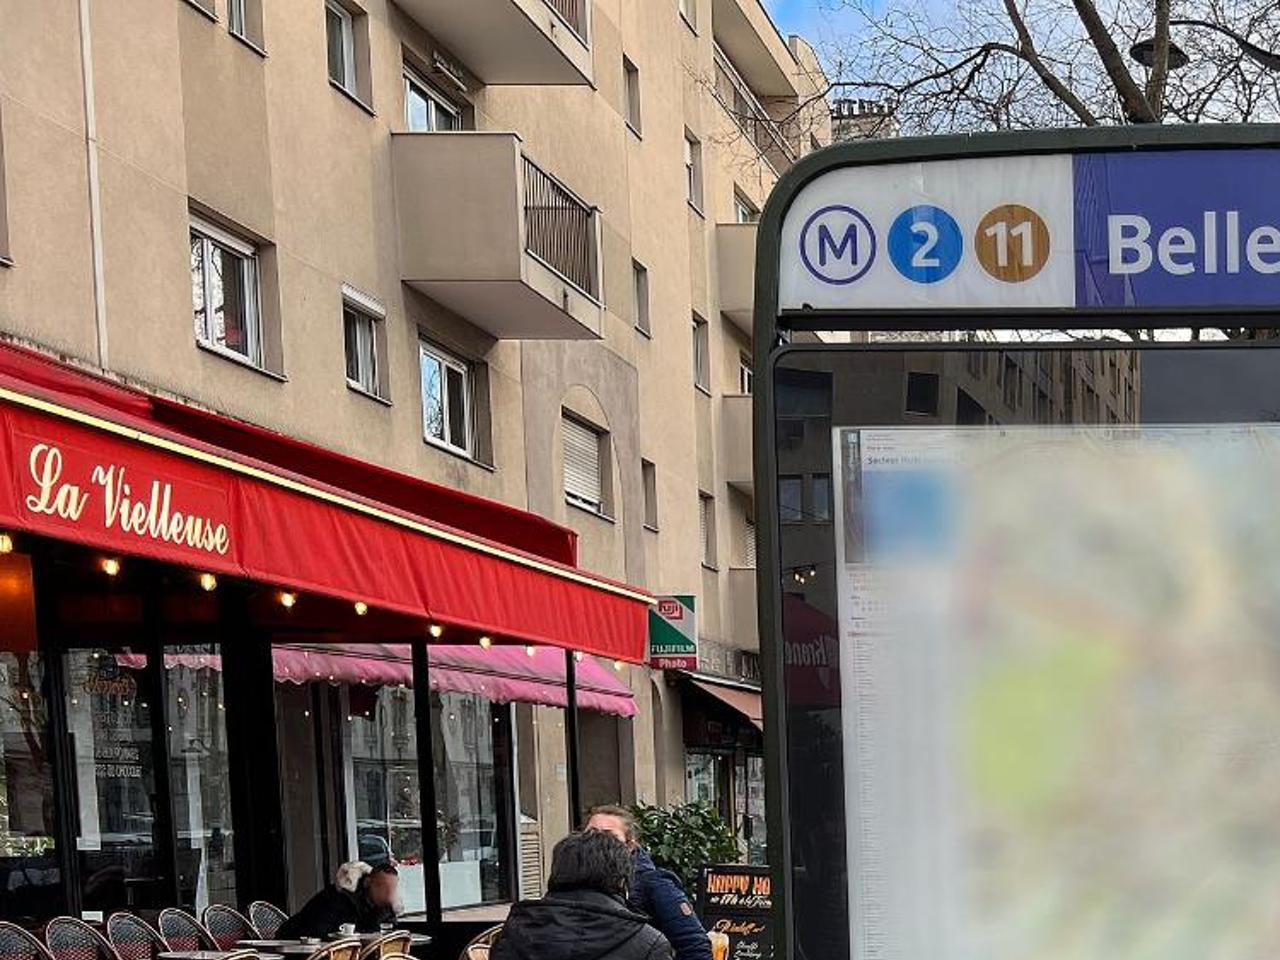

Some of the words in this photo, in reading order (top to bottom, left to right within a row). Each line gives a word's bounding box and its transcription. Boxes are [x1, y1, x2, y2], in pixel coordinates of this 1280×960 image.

[818, 222, 858, 267] M
[910, 220, 940, 267] 2
[983, 220, 1034, 267] 11
[26, 443, 90, 521] La
[91, 464, 229, 555] Vielleuse
[651, 644, 695, 653] FUJIFILM
[659, 658, 688, 669] Photo
[706, 873, 750, 895] HAPPY
